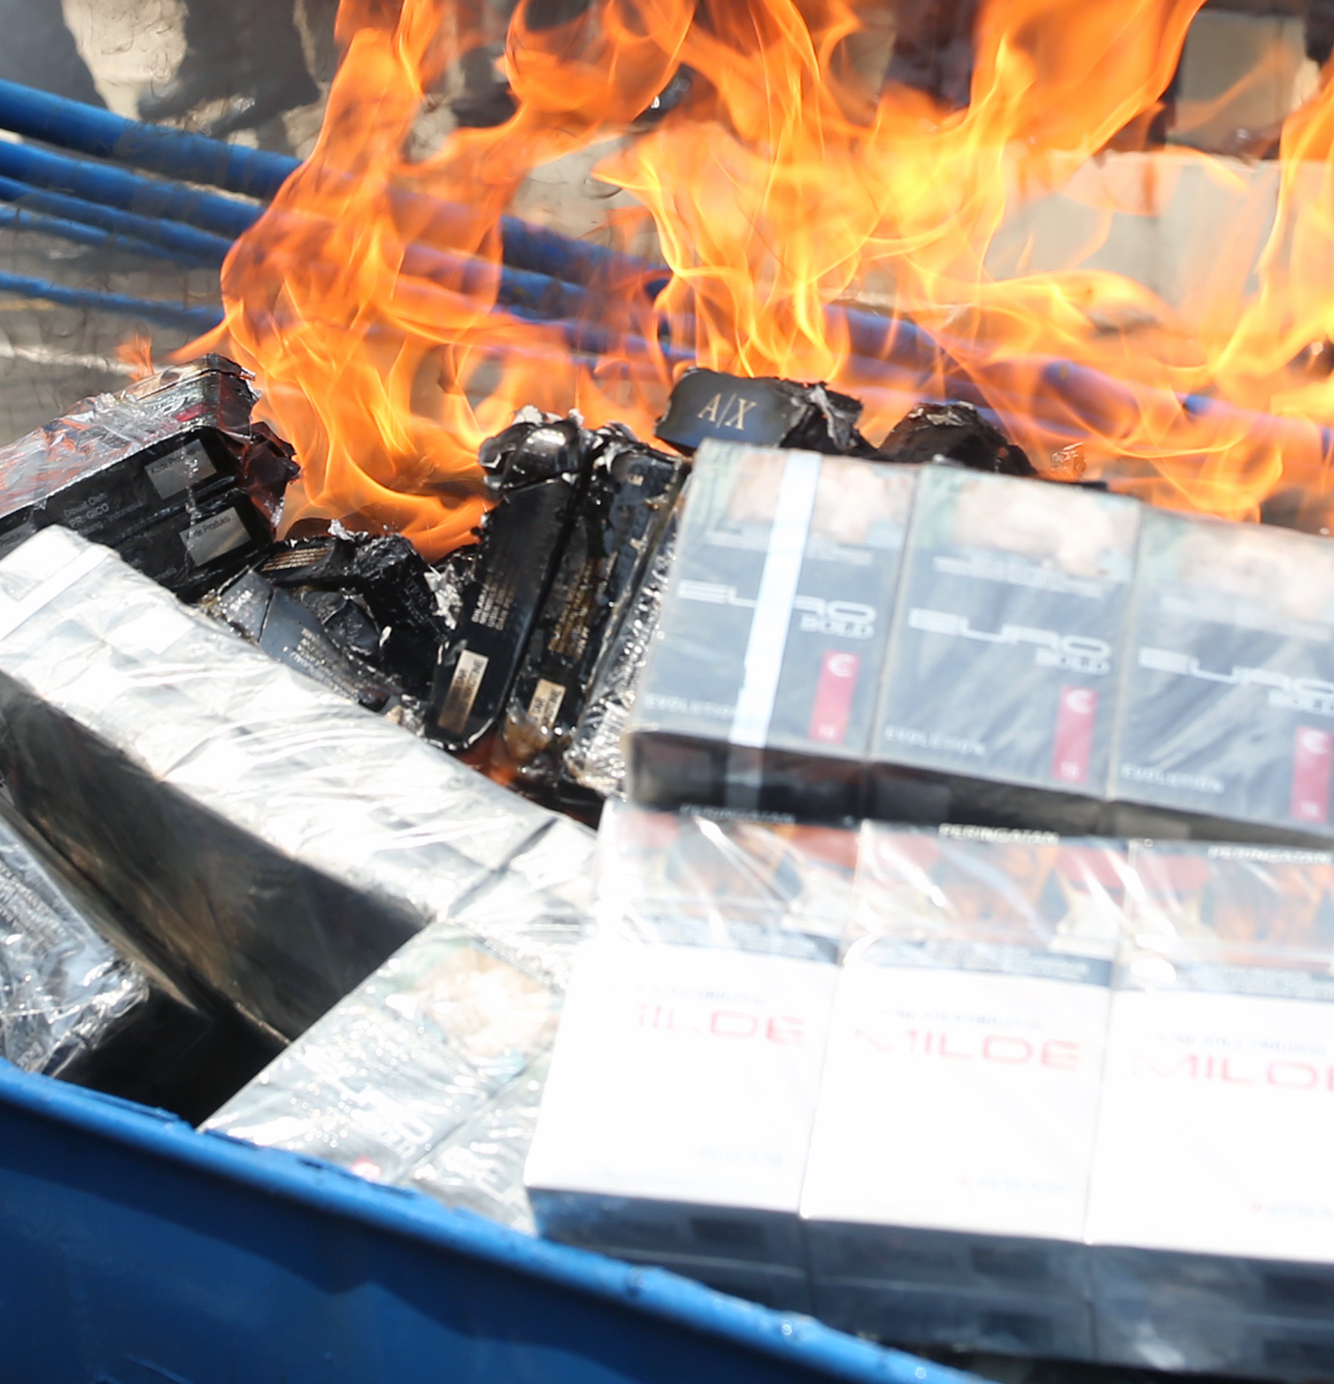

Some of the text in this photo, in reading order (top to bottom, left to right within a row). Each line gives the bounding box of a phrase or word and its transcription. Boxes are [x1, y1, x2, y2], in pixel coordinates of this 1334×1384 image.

[698, 392, 757, 430] A/X
[86, 503, 110, 520] GICO
[800, 615, 875, 640] BOLD
[908, 606, 1112, 660] EURO
[1034, 646, 1110, 676] BOLD
